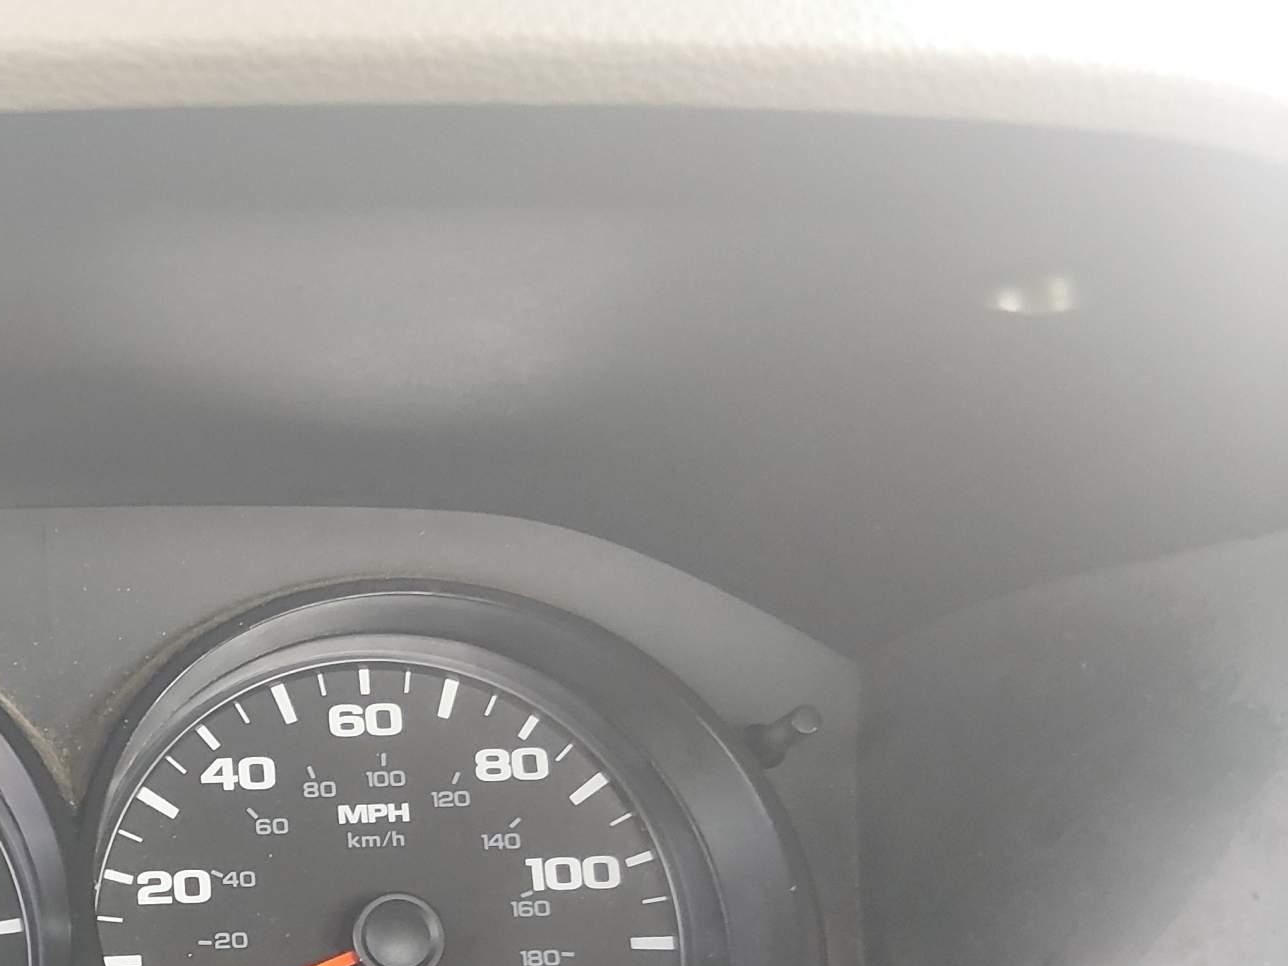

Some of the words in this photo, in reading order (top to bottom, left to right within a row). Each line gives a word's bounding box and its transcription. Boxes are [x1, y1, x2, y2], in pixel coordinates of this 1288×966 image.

[328, 702, 403, 738] 60
[200, 756, 276, 791] 40
[474, 747, 549, 782] 80
[366, 770, 406, 787] 100
[303, 781, 337, 798] 80
[431, 790, 471, 808] 120
[337, 803, 410, 825] MPH
[256, 817, 289, 835] 60
[347, 830, 406, 848] km/h
[480, 832, 521, 850] 140
[221, 870, 256, 888] 40
[524, 855, 621, 892] 100
[136, 869, 212, 905] 20
[510, 900, 551, 917] 160
[214, 931, 249, 950] 20
[520, 949, 561, 966] 180
